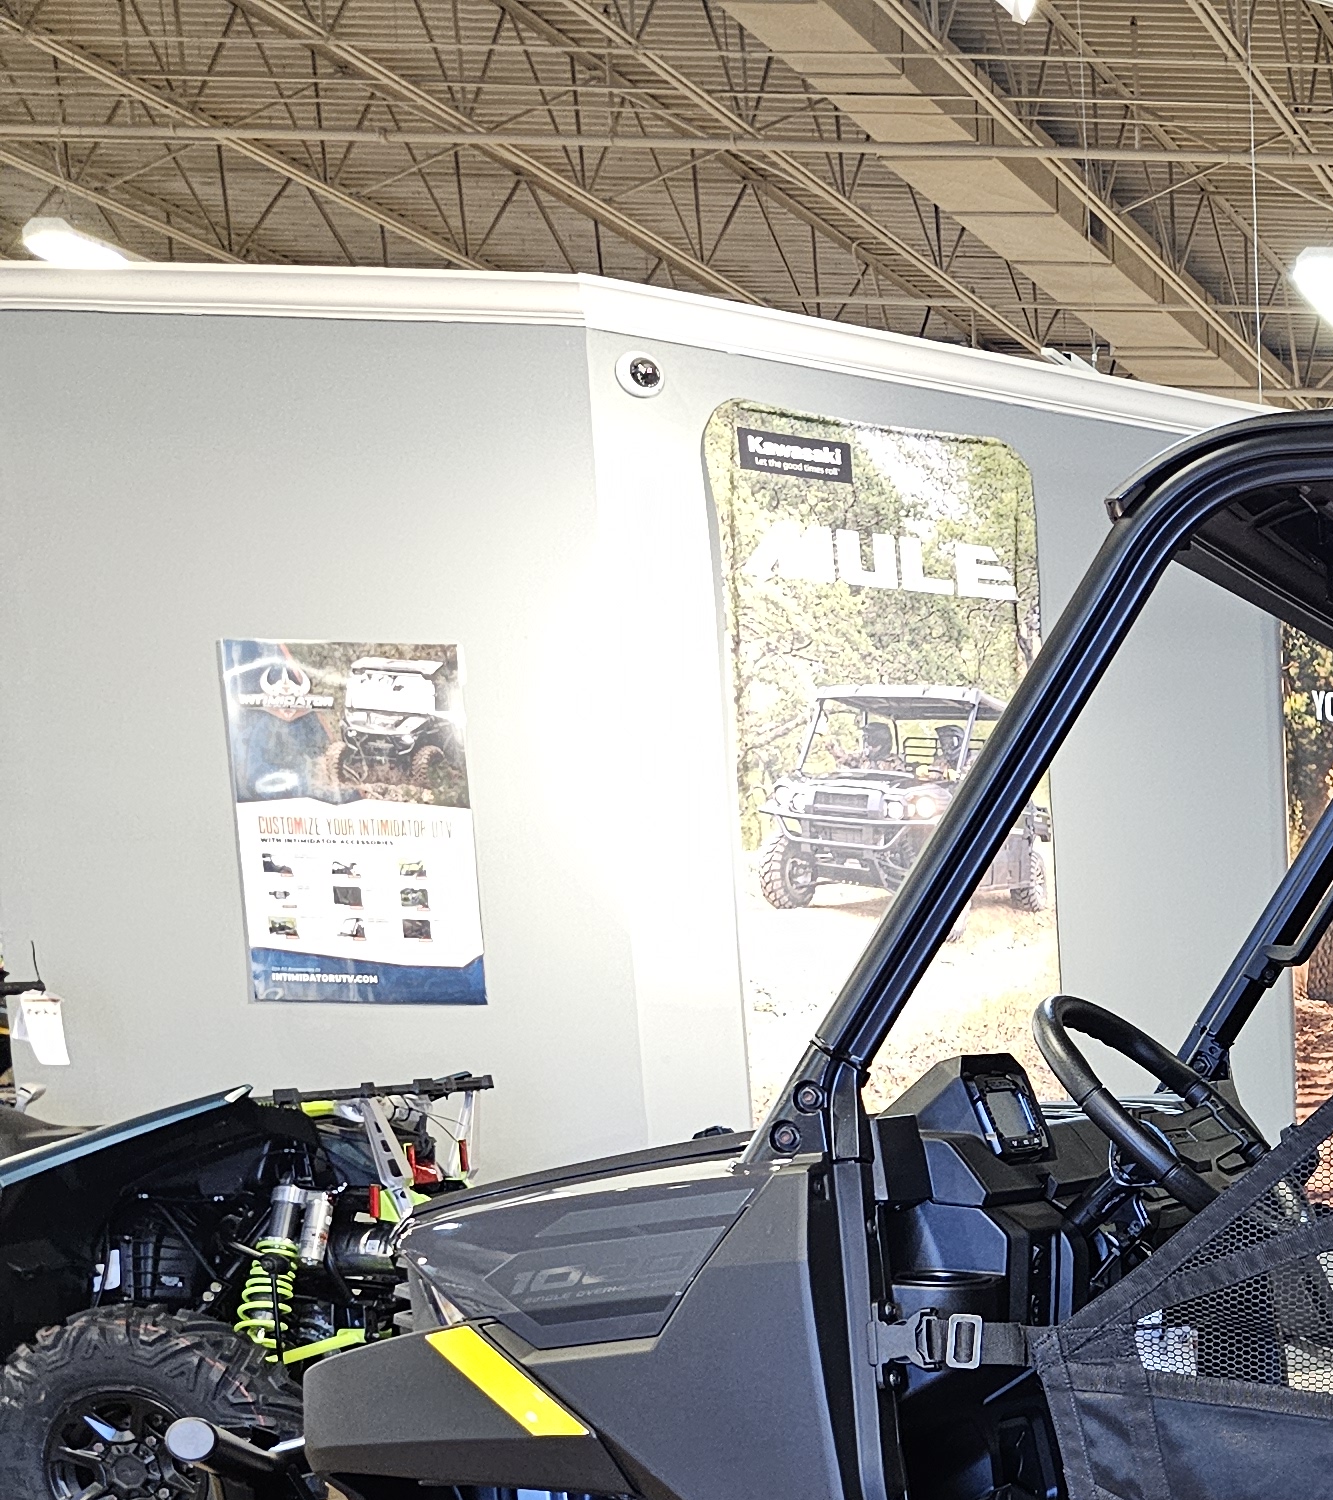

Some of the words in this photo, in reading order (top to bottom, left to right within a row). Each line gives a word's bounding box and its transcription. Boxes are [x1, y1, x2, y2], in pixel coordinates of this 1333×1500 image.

[747, 434, 843, 465] Kawasaki
[755, 456, 768, 467] Let
[768, 458, 782, 468] the
[783, 461, 803, 472] good
[804, 463, 824, 475] times
[746, 519, 1019, 601] MULE
[258, 815, 321, 836] CUSTOMIZE
[326, 817, 355, 836] YOUR
[359, 818, 426, 838] INTIMIDATOR
[431, 820, 452, 839] UTV
[271, 972, 379, 984] INTIMIDATORUTV.COM
[524, 1291, 570, 1304] SINGLE
